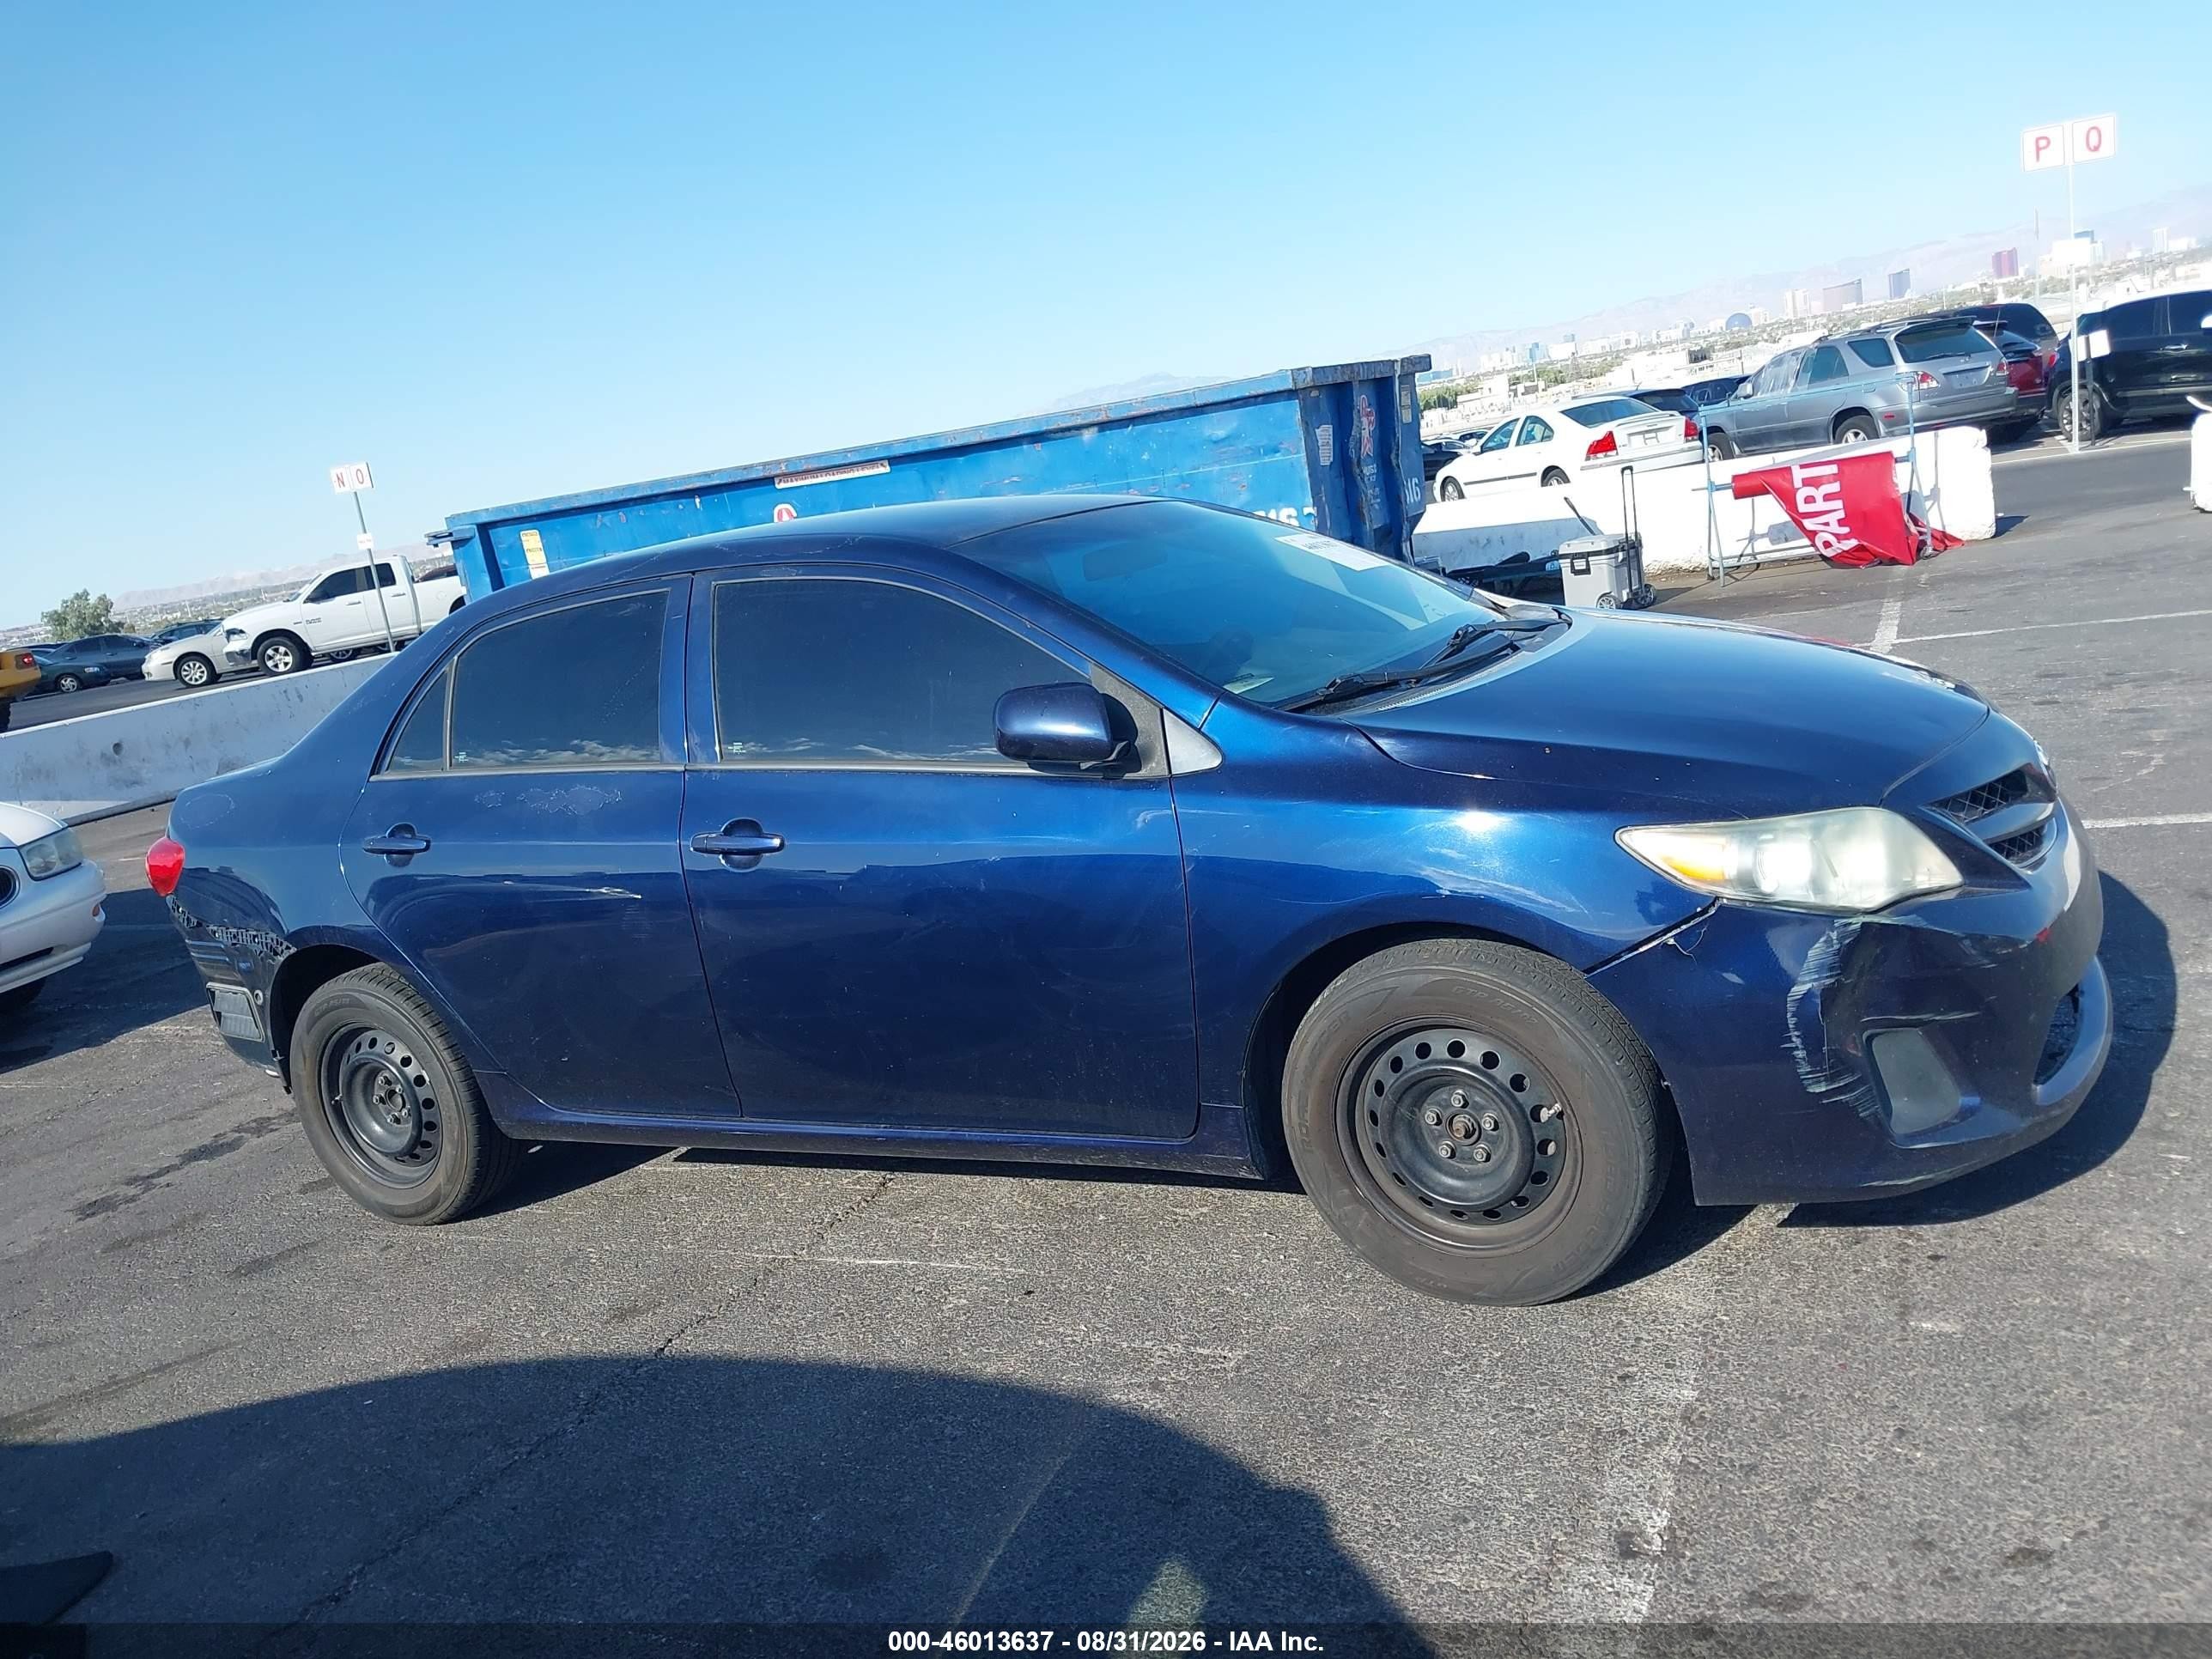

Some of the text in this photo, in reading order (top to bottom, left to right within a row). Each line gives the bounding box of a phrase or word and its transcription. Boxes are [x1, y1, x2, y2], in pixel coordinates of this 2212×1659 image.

[2035, 126, 2102, 163] P Q
[336, 471, 345, 489] N
